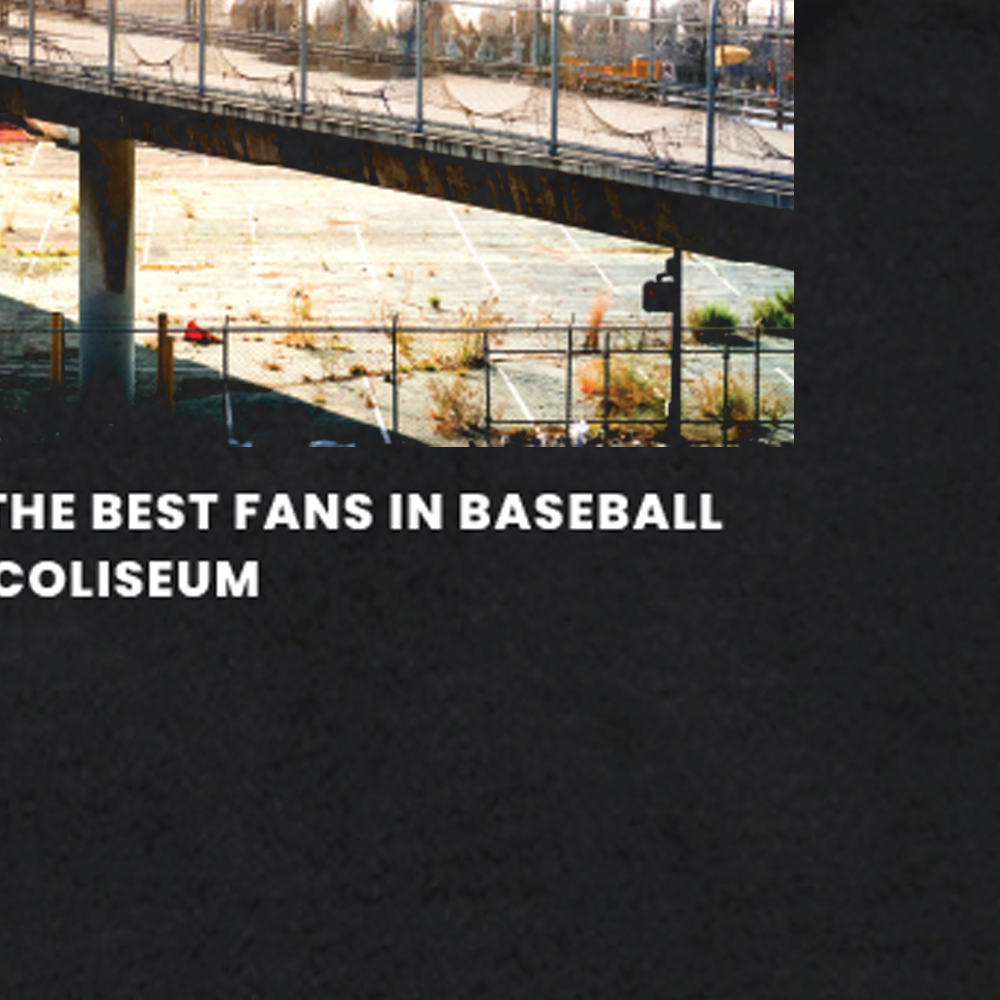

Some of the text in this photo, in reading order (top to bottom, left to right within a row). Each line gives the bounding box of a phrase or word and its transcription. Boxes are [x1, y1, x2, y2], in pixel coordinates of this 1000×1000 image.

[92, 493, 219, 530] BEST
[235, 493, 373, 530] FANS
[390, 493, 443, 530] IN
[459, 493, 723, 530] BASEBALL
